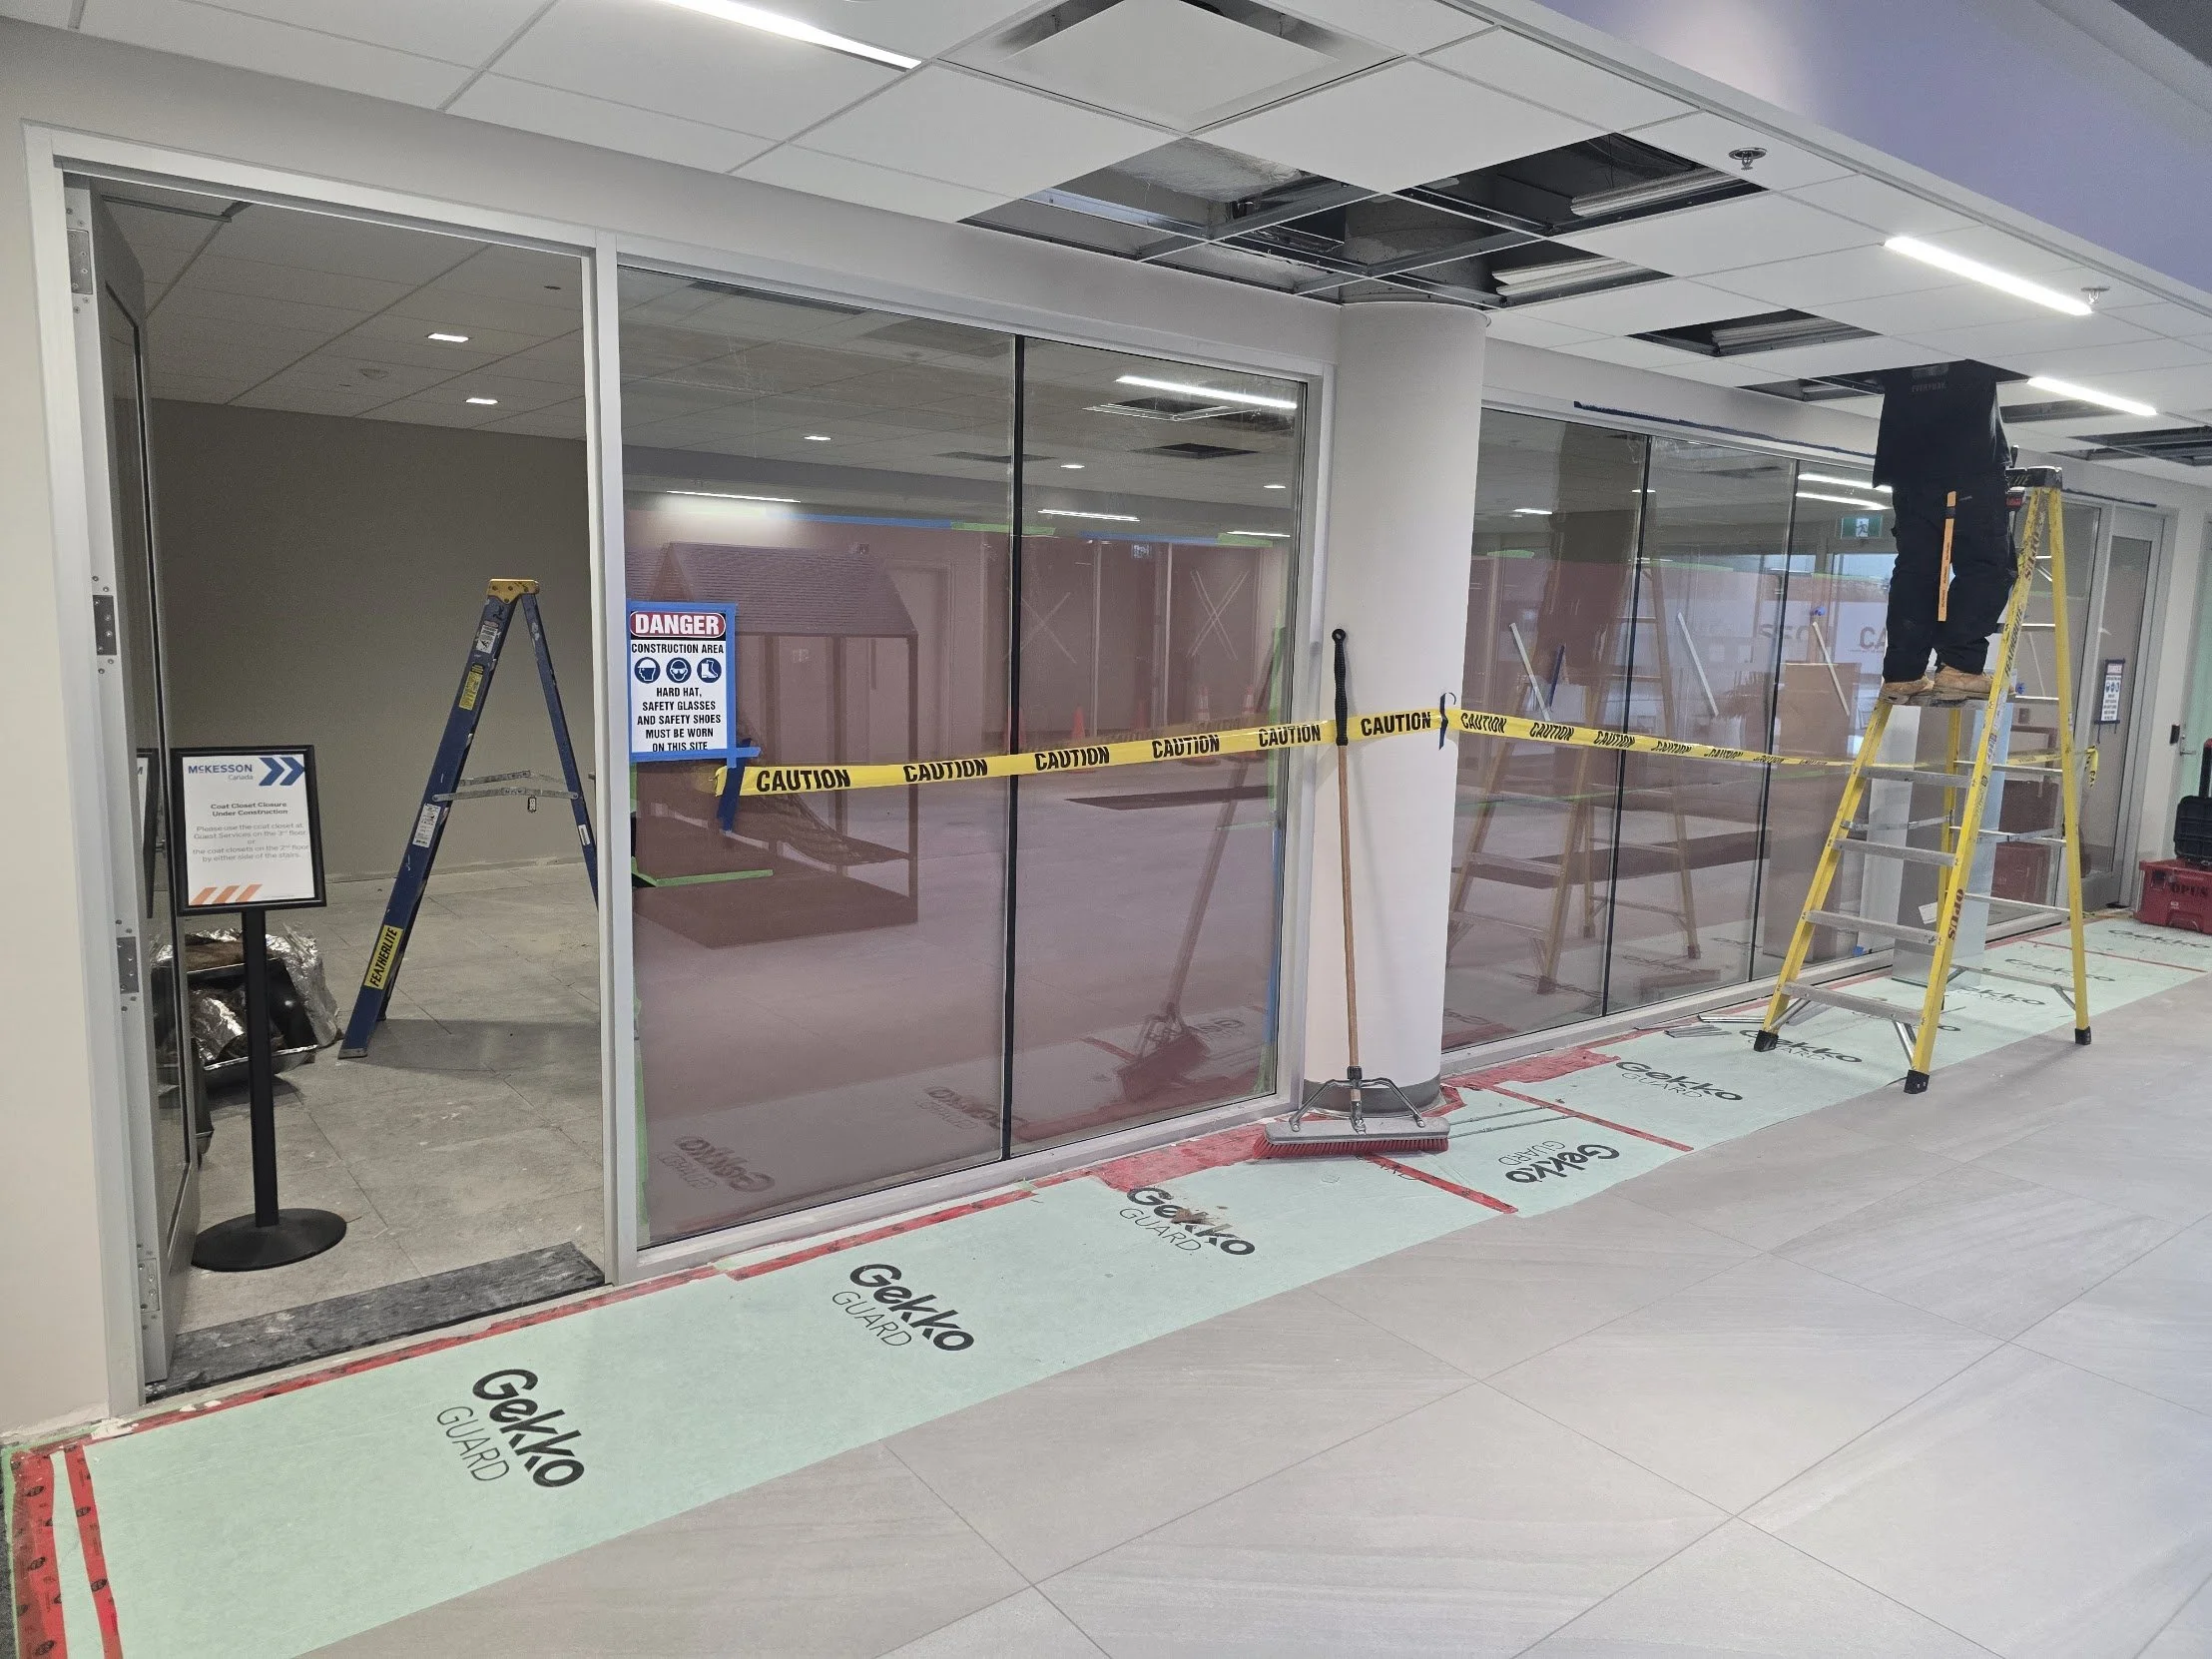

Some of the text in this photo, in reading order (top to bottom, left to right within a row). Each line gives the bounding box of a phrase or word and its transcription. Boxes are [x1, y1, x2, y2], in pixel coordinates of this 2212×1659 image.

[635, 613, 720, 635] DANGER
[2004, 608, 2023, 678] FEATHERLITE
[631, 643, 725, 654] CONSTRUCTION AREA
[642, 701, 716, 712] SAFETY GLASSES
[656, 687, 702, 698] HARD HAT,
[637, 714, 721, 726] AND SAFETY SHOES
[645, 728, 714, 739] MUST BE WORN
[1460, 712, 1506, 734] CAUTION
[1529, 722, 1575, 741] CAUTION
[1592, 729, 1636, 748] CAUTION
[652, 741, 708, 753] ON THIS SITE
[755, 768, 851, 793] CAUTION
[903, 759, 988, 783] CAUTION
[1034, 746, 1110, 773] CAUTION
[1151, 734, 1220, 759] CAUTION
[1258, 724, 1321, 748] CAUTION
[1360, 711, 1431, 737] CAUTION
[1947, 888, 1964, 940] OPUS
[369, 926, 397, 988] FEATHERLITE
[2004, 958, 2116, 981] Geko
[1615, 1061, 1743, 1101] Gekko
[1621, 1072, 1703, 1099] GUARD
[1498, 1140, 1566, 1166] GUARD
[1505, 1144, 1620, 1184] Gekko
[1119, 1208, 1202, 1251] GUARD
[831, 1291, 912, 1347] GUARD
[849, 1263, 975, 1352] Gekko
[436, 1405, 510, 1481] GUARD
[472, 1369, 585, 1488] Gekko
